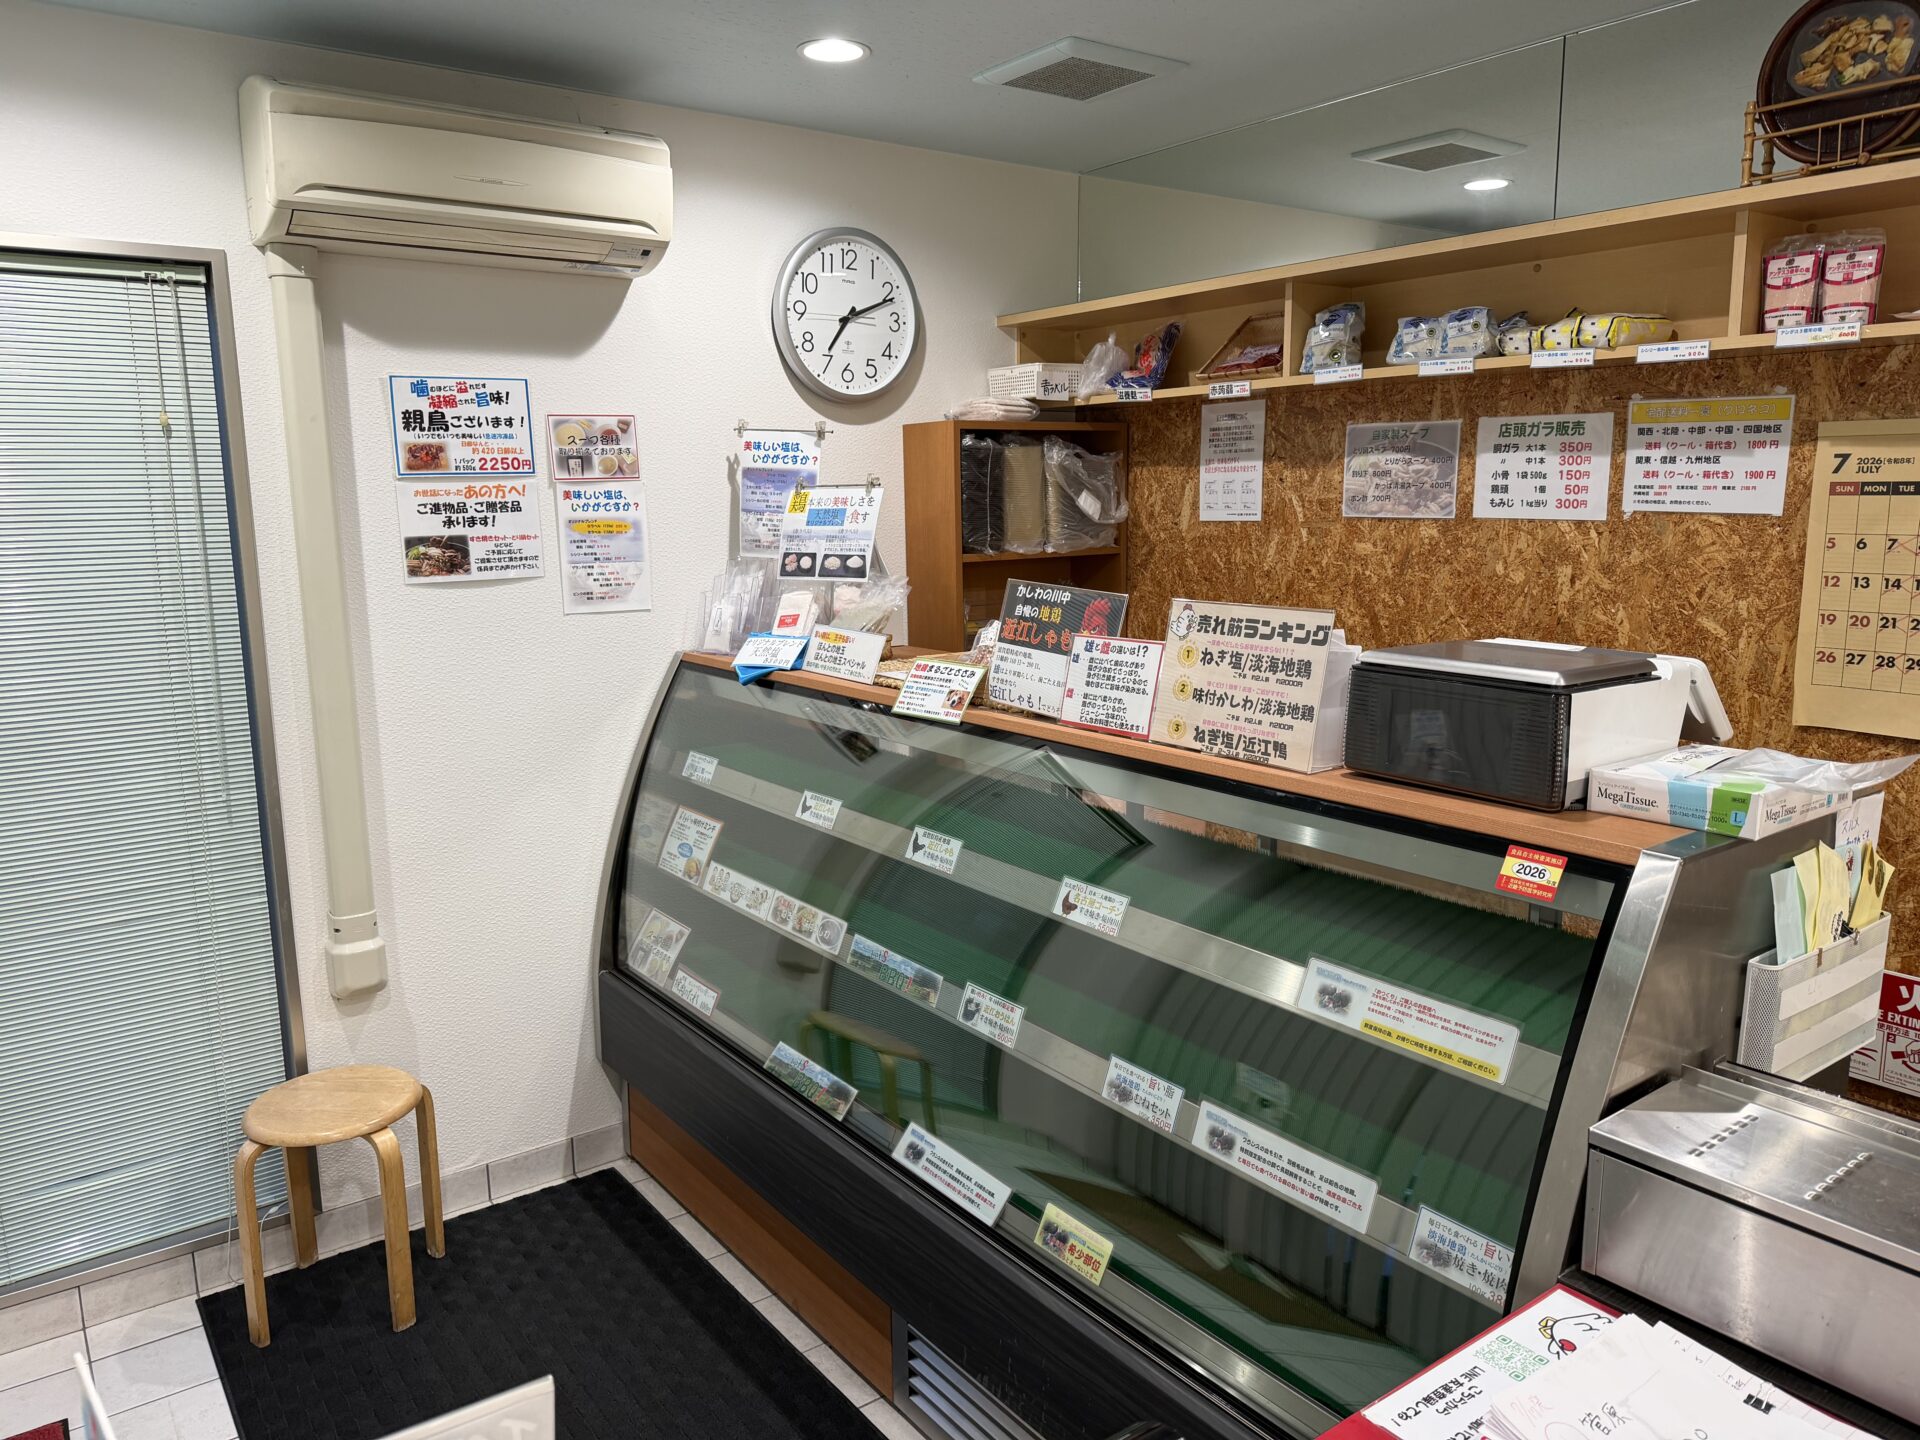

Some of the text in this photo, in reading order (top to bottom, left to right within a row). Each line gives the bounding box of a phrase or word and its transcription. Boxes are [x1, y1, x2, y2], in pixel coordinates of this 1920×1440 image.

[821, 252, 833, 273] 11
[841, 248, 858, 271] 12
[871, 259, 874, 279] 1
[801, 272, 818, 294] 10
[882, 281, 894, 302] 2
[793, 300, 807, 321] 9
[889, 312, 900, 332] 3
[802, 331, 814, 352] 8
[882, 341, 893, 360] 4
[822, 353, 833, 374] 7
[865, 358, 877, 378] 5
[841, 363, 854, 383] 6
[401, 410, 524, 432] 親鳥ございます！
[1498, 421, 1586, 438] 店頭ガラ販売
[1637, 424, 1782, 436] 関西・北陸・中部・中国・四国地区
[744, 441, 804, 452] 美味しい塩は、
[1559, 442, 1592, 452] 350円
[479, 457, 531, 470] 2250円
[752, 454, 818, 465] いかがですか？
[1559, 456, 1591, 466] 300円
[1635, 456, 1721, 465] 関東・信越・九州地区
[1832, 454, 1852, 474] 7
[1492, 471, 1509, 480] 小骨
[1559, 470, 1590, 480] 150円
[1856, 466, 1881, 474] JULY
[563, 490, 627, 500] 美味しい塩は、
[1491, 485, 1508, 494] 鶏頭
[1564, 485, 1588, 494] 50円
[416, 501, 522, 514] ご進物品・ご贈答品
[571, 502, 639, 512] いかがですか？
[1490, 498, 1514, 508] もみじ
[1555, 499, 1587, 509] 300円
[442, 516, 496, 528] 承ります！
[1826, 538, 1898, 550] 5 6 7
[1823, 576, 1901, 589] 12 13 14
[1016, 584, 1071, 604] かしわの川中
[1014, 604, 1062, 623] 自慢の地鶏
[1820, 614, 1897, 628] 19 20 21
[1001, 618, 1073, 652] 近江しゃも
[1197, 614, 1331, 646] 売れ筋ランキング
[746, 638, 804, 648] オリジナルブレンド
[1816, 651, 1896, 668] 26 27 28
[1179, 683, 1186, 693] 2
[1173, 723, 1181, 732] 3
[1516, 864, 1546, 879] 2026
[1068, 1243, 1101, 1273] 希少部位
[1460, 1366, 1485, 1382] LINE
[1436, 1386, 1483, 1416] こちらから
